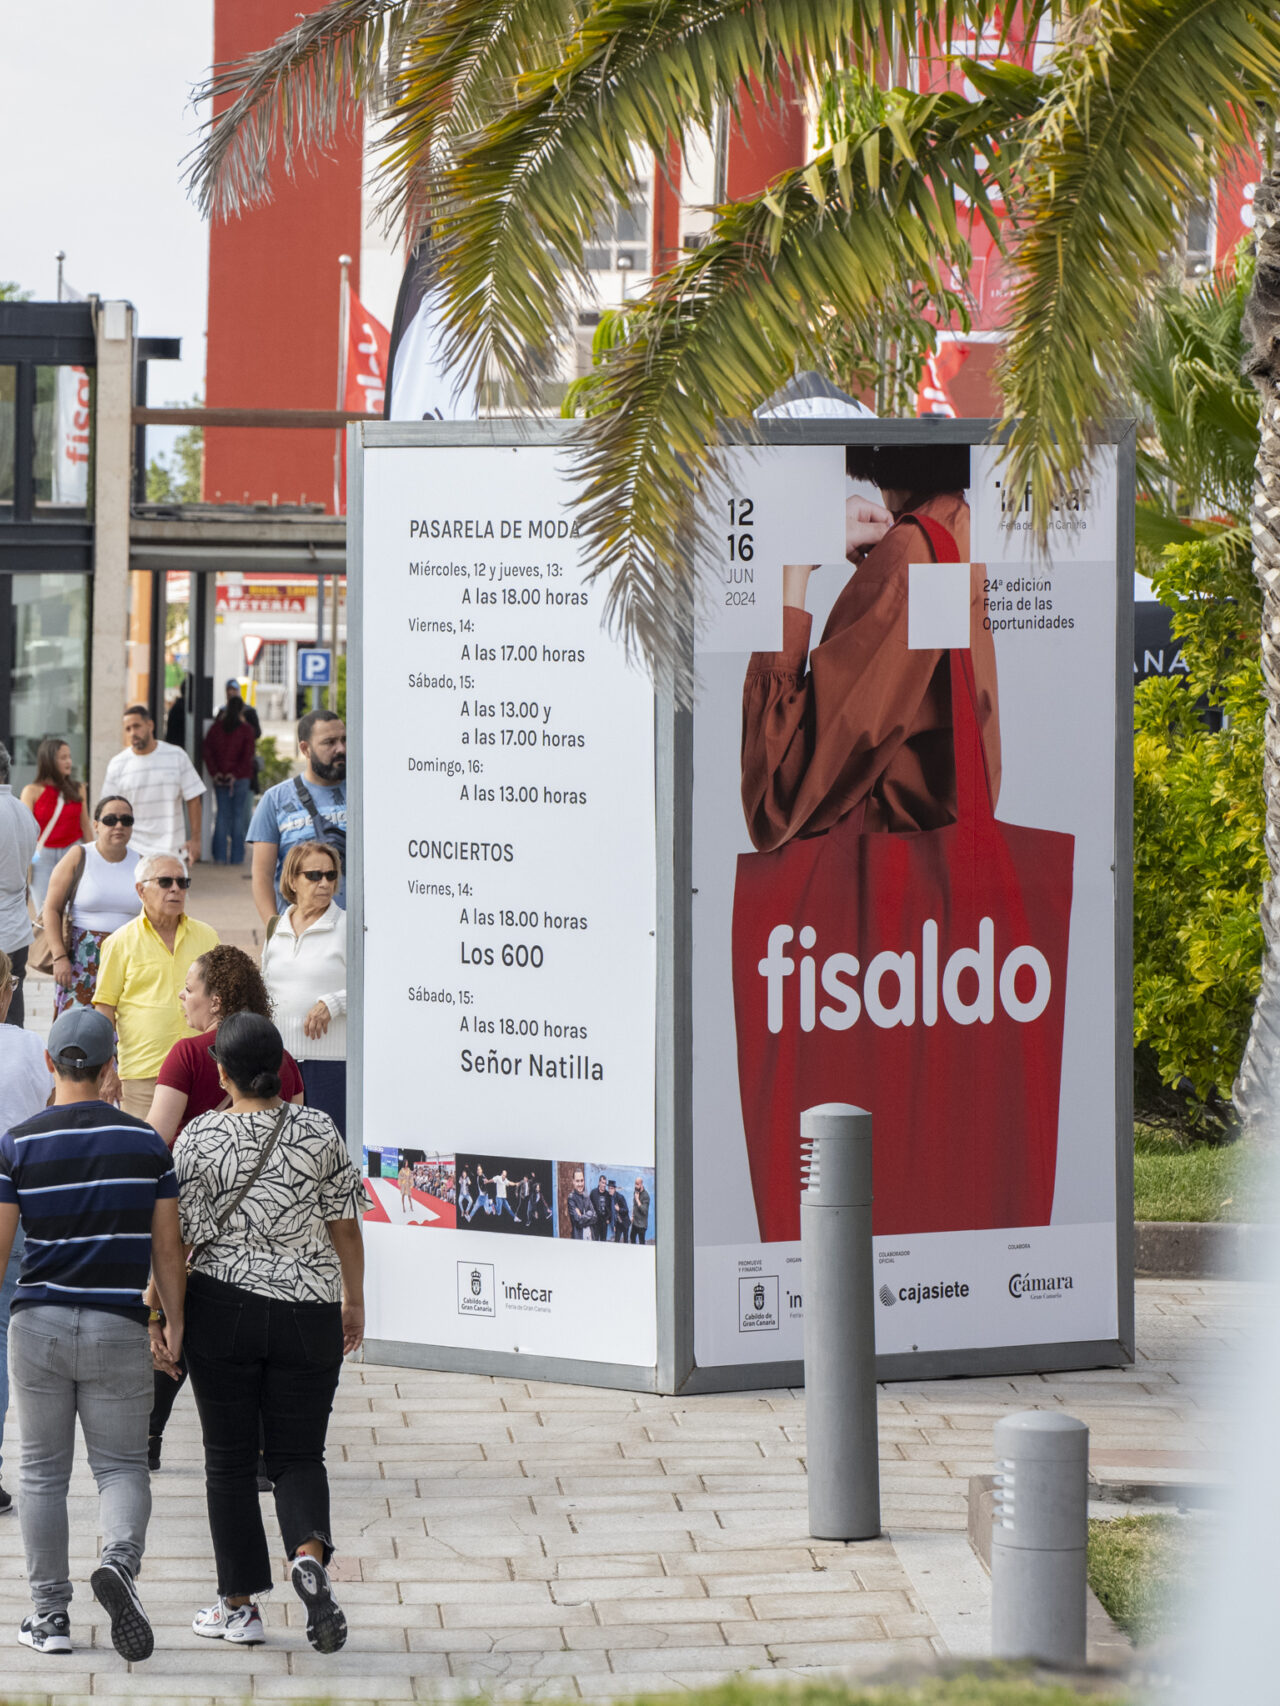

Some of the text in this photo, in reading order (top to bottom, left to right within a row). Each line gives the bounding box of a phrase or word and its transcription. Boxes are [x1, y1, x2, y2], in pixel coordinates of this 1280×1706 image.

[728, 498, 753, 525] 12
[411, 520, 581, 538] PASARELA DE MODA
[728, 534, 753, 561] 16
[410, 560, 562, 581] Miércoles, 12 y jueves, 13:
[726, 568, 754, 584] JUN
[462, 588, 588, 605] A las 18.00 horas
[726, 592, 755, 605] 2024
[982, 596, 1052, 612] Feria de las
[409, 617, 474, 634] Viernes, 14:
[982, 614, 1074, 634] Oportunidades
[461, 644, 585, 662] A las 17.00 horas
[306, 655, 326, 680] P
[409, 672, 474, 690] Sábado, 15:
[461, 700, 551, 724] A las 13.00 y
[462, 728, 585, 747] a las 17.00 horas
[409, 758, 483, 777] Domingo, 16:
[460, 784, 586, 804] A las 13.00 horas
[409, 840, 513, 862] CONCIERTOS
[408, 880, 472, 898] Viernes, 14:
[460, 908, 587, 929] A las 18.00 horas
[462, 942, 543, 968] Los 600
[758, 916, 1052, 1034] fisaldo
[409, 986, 473, 1005] Sábado, 15:
[460, 1016, 587, 1039] A las 18.00 horas
[461, 1049, 603, 1080] Señor Natilla
[502, 1281, 552, 1302] infecar
[899, 1282, 969, 1303] cajasiete
